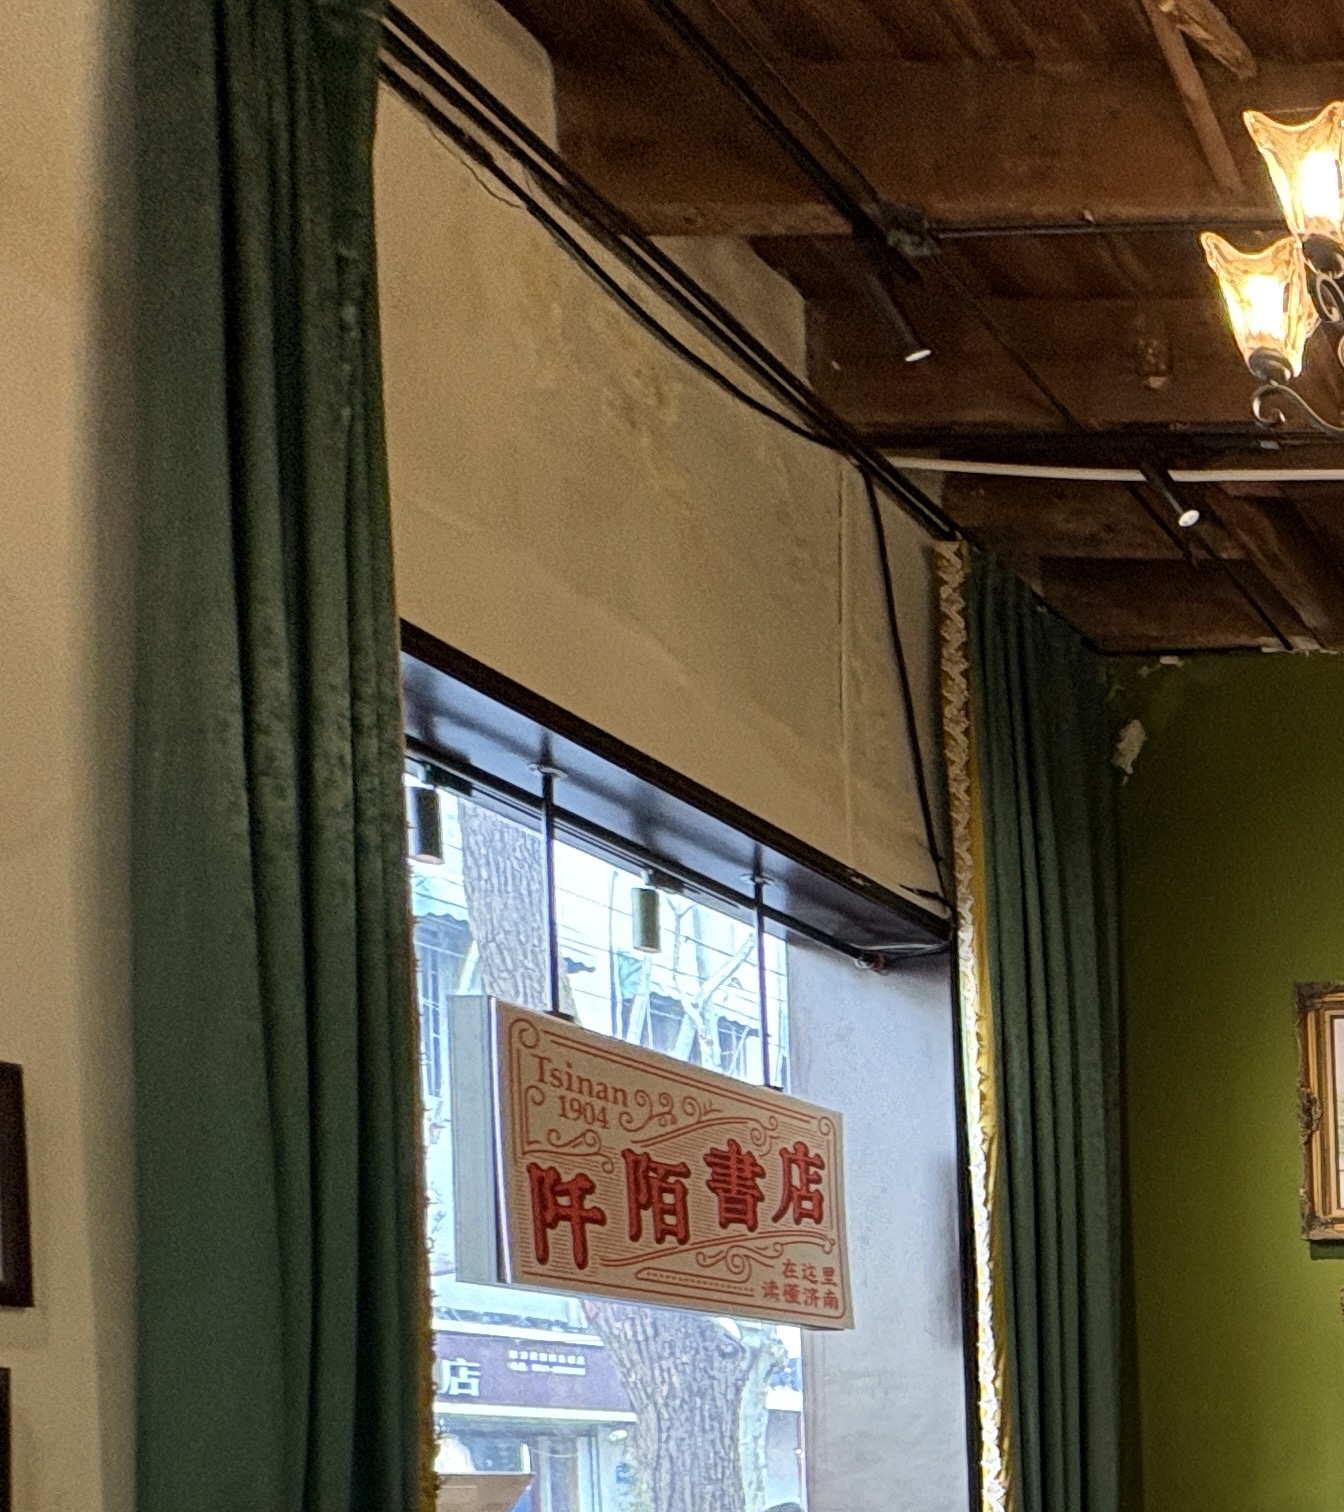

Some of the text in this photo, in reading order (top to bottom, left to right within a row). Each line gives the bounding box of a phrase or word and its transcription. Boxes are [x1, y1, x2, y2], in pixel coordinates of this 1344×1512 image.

[531, 1055, 628, 1108] Tsinan
[558, 1095, 609, 1129] 1904
[526, 1138, 826, 1270] 阡陌書店
[782, 1258, 837, 1287] 在这里
[761, 1280, 839, 1309] 读懂济南
